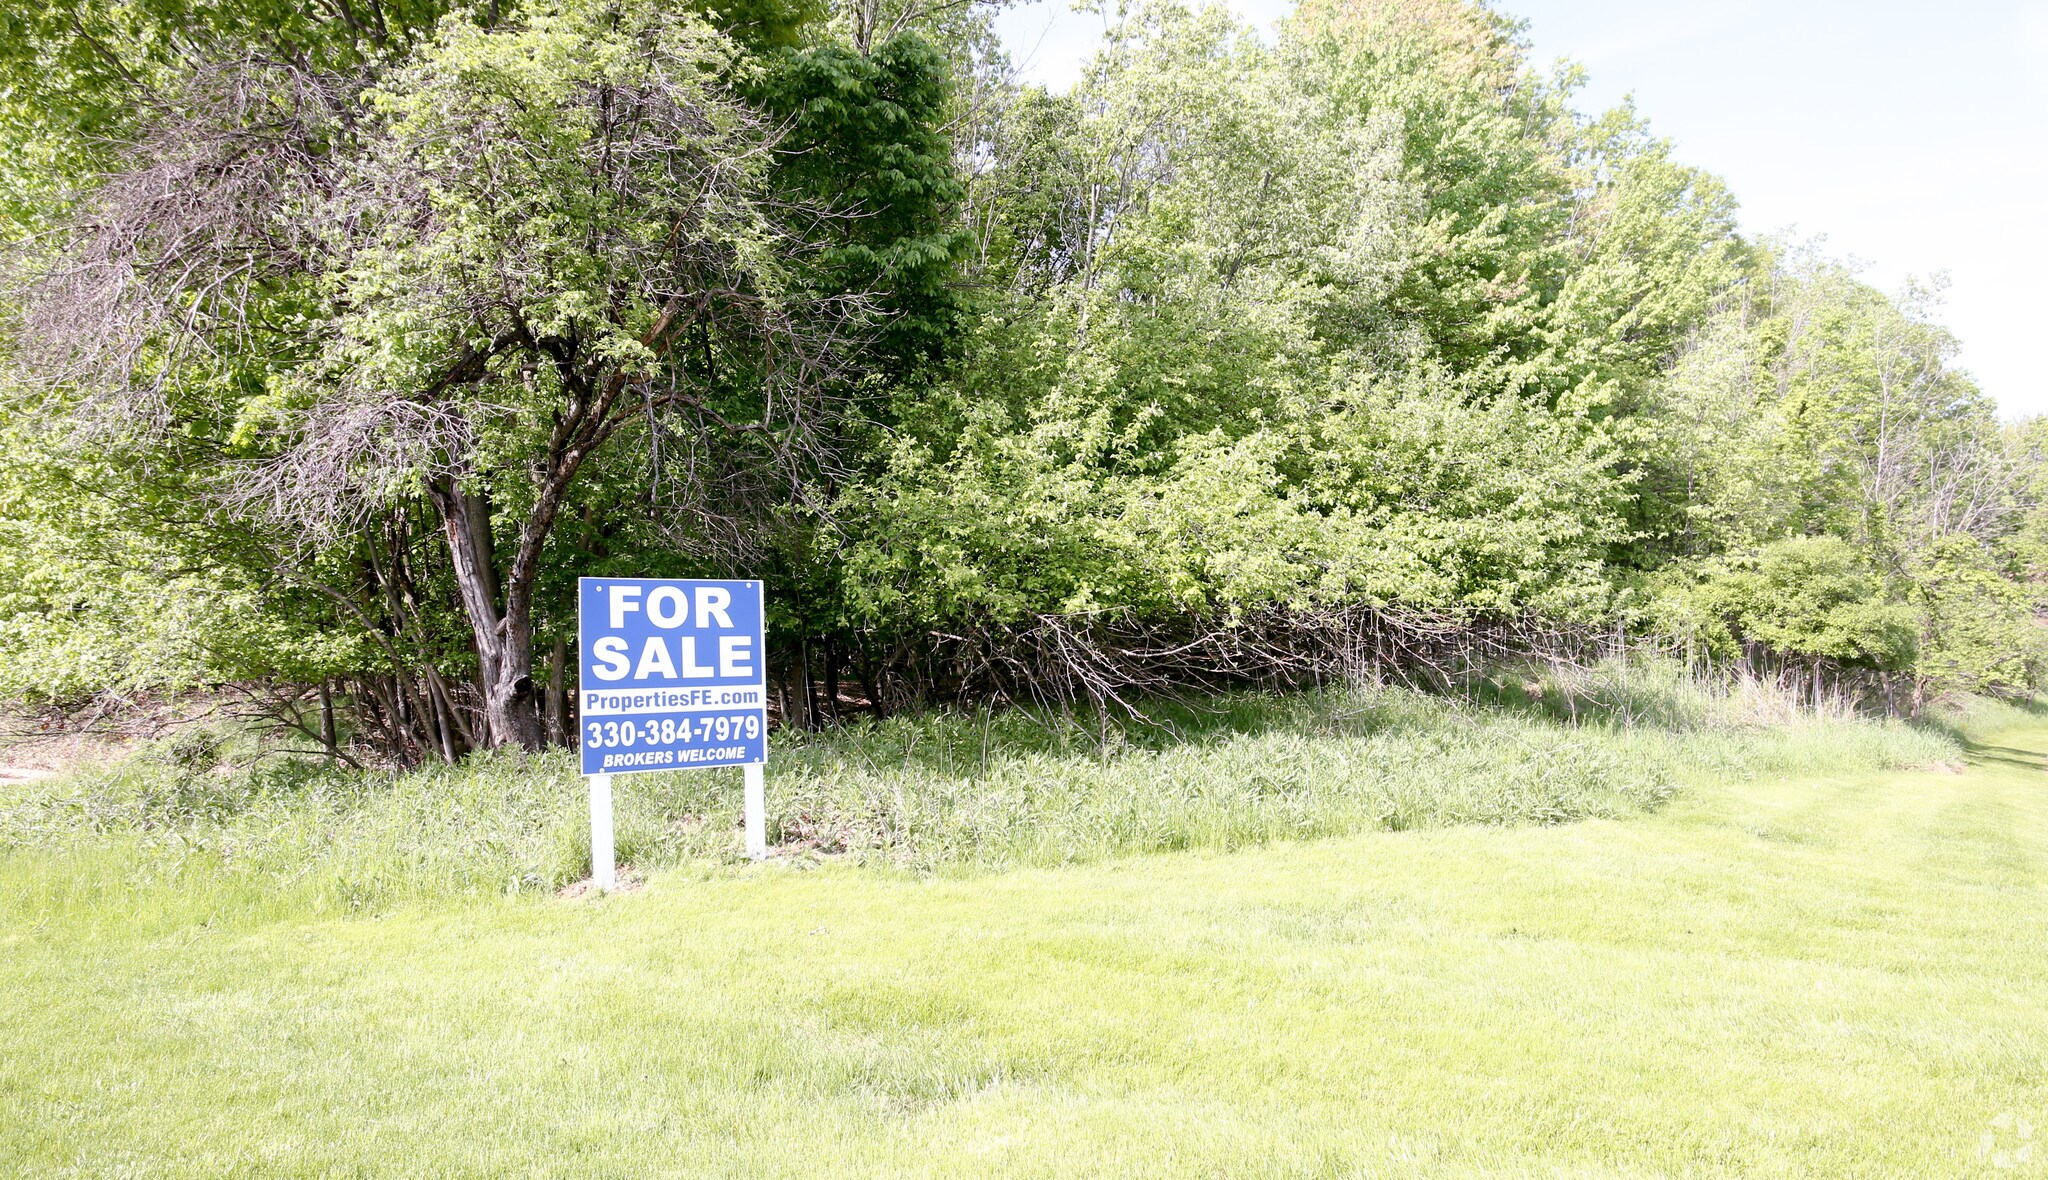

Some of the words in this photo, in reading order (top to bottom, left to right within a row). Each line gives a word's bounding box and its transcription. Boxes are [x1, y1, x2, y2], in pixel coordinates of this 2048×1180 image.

[609, 585, 734, 629] FOR
[592, 635, 753, 681] SALE
[586, 689, 758, 712] PropertiesFE.com
[587, 715, 759, 749] 330-384-7979
[603, 751, 674, 768] BROKERS
[677, 746, 746, 762] WELCOME
